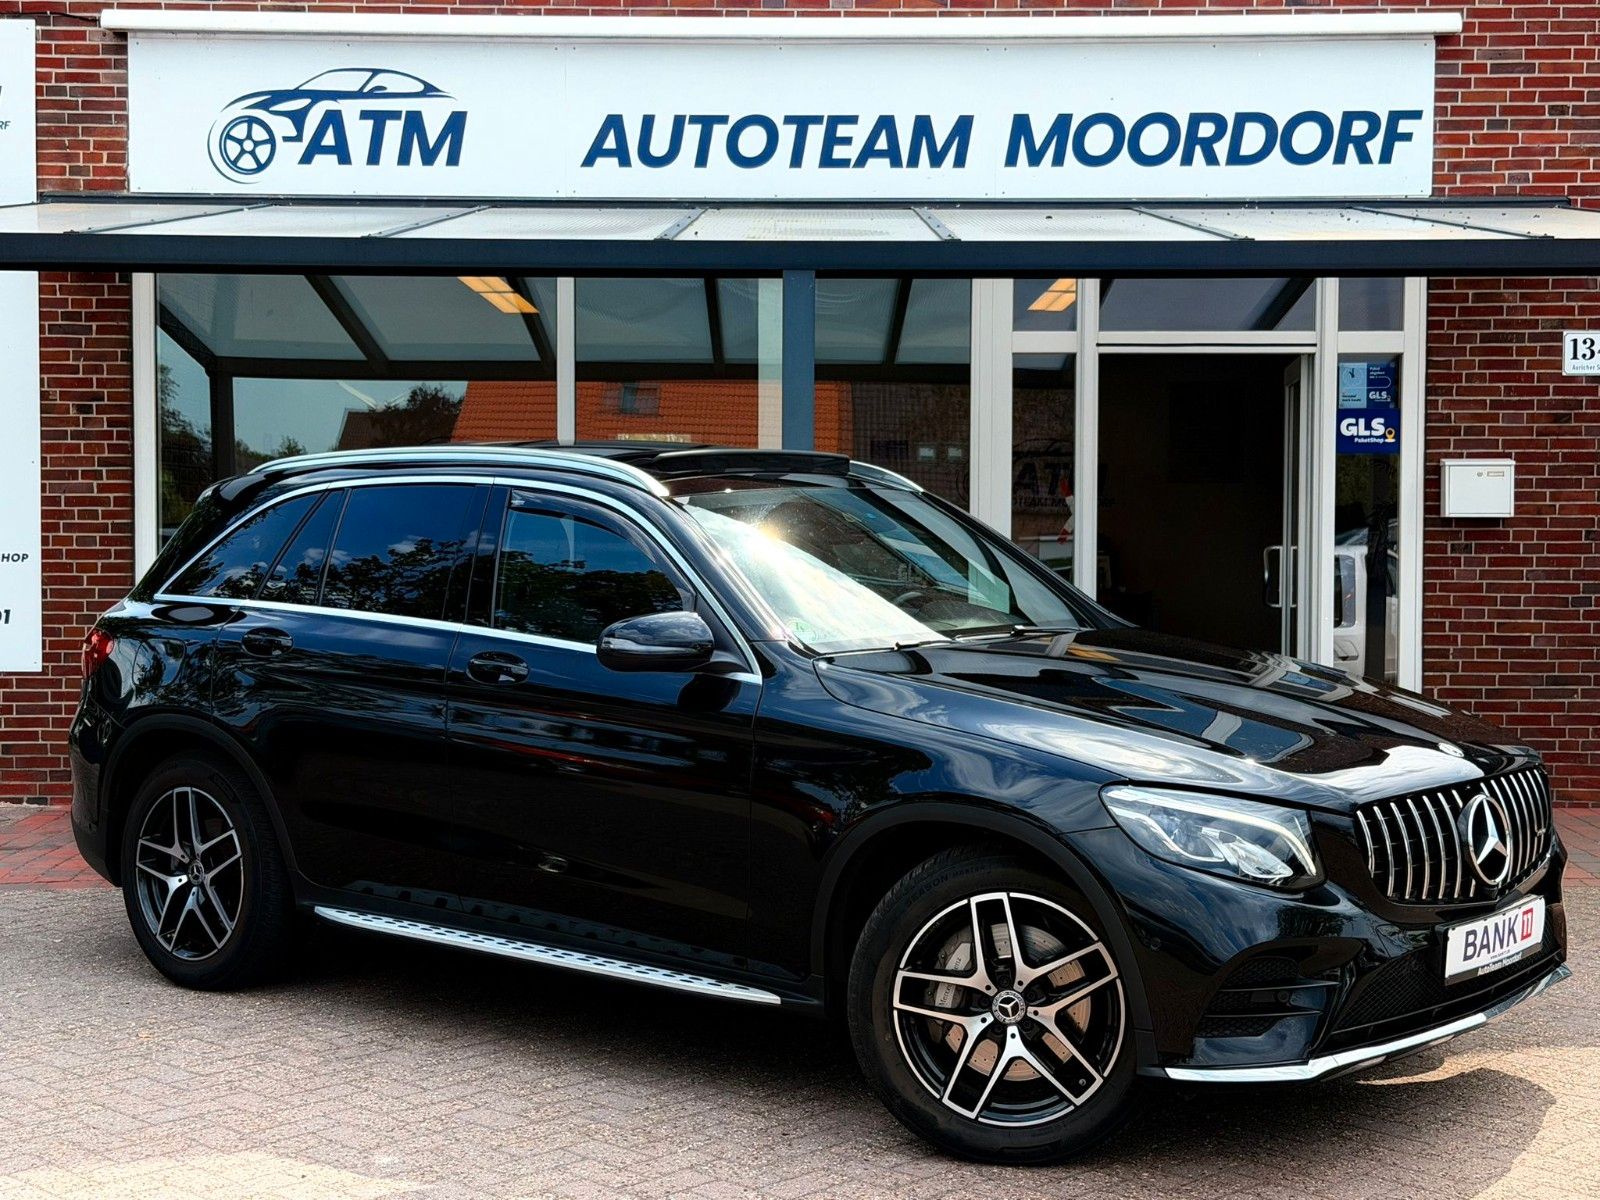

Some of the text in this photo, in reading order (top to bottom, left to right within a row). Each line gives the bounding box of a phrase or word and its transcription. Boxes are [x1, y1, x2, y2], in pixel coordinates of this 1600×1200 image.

[297, 109, 468, 167] ATM
[580, 109, 1424, 169] AUTOTEAM MOORDORF
[1570, 337, 1600, 361] 13
[1368, 391, 1387, 399] GLS
[1340, 418, 1385, 436] GLS
[1463, 913, 1519, 962] BANK
